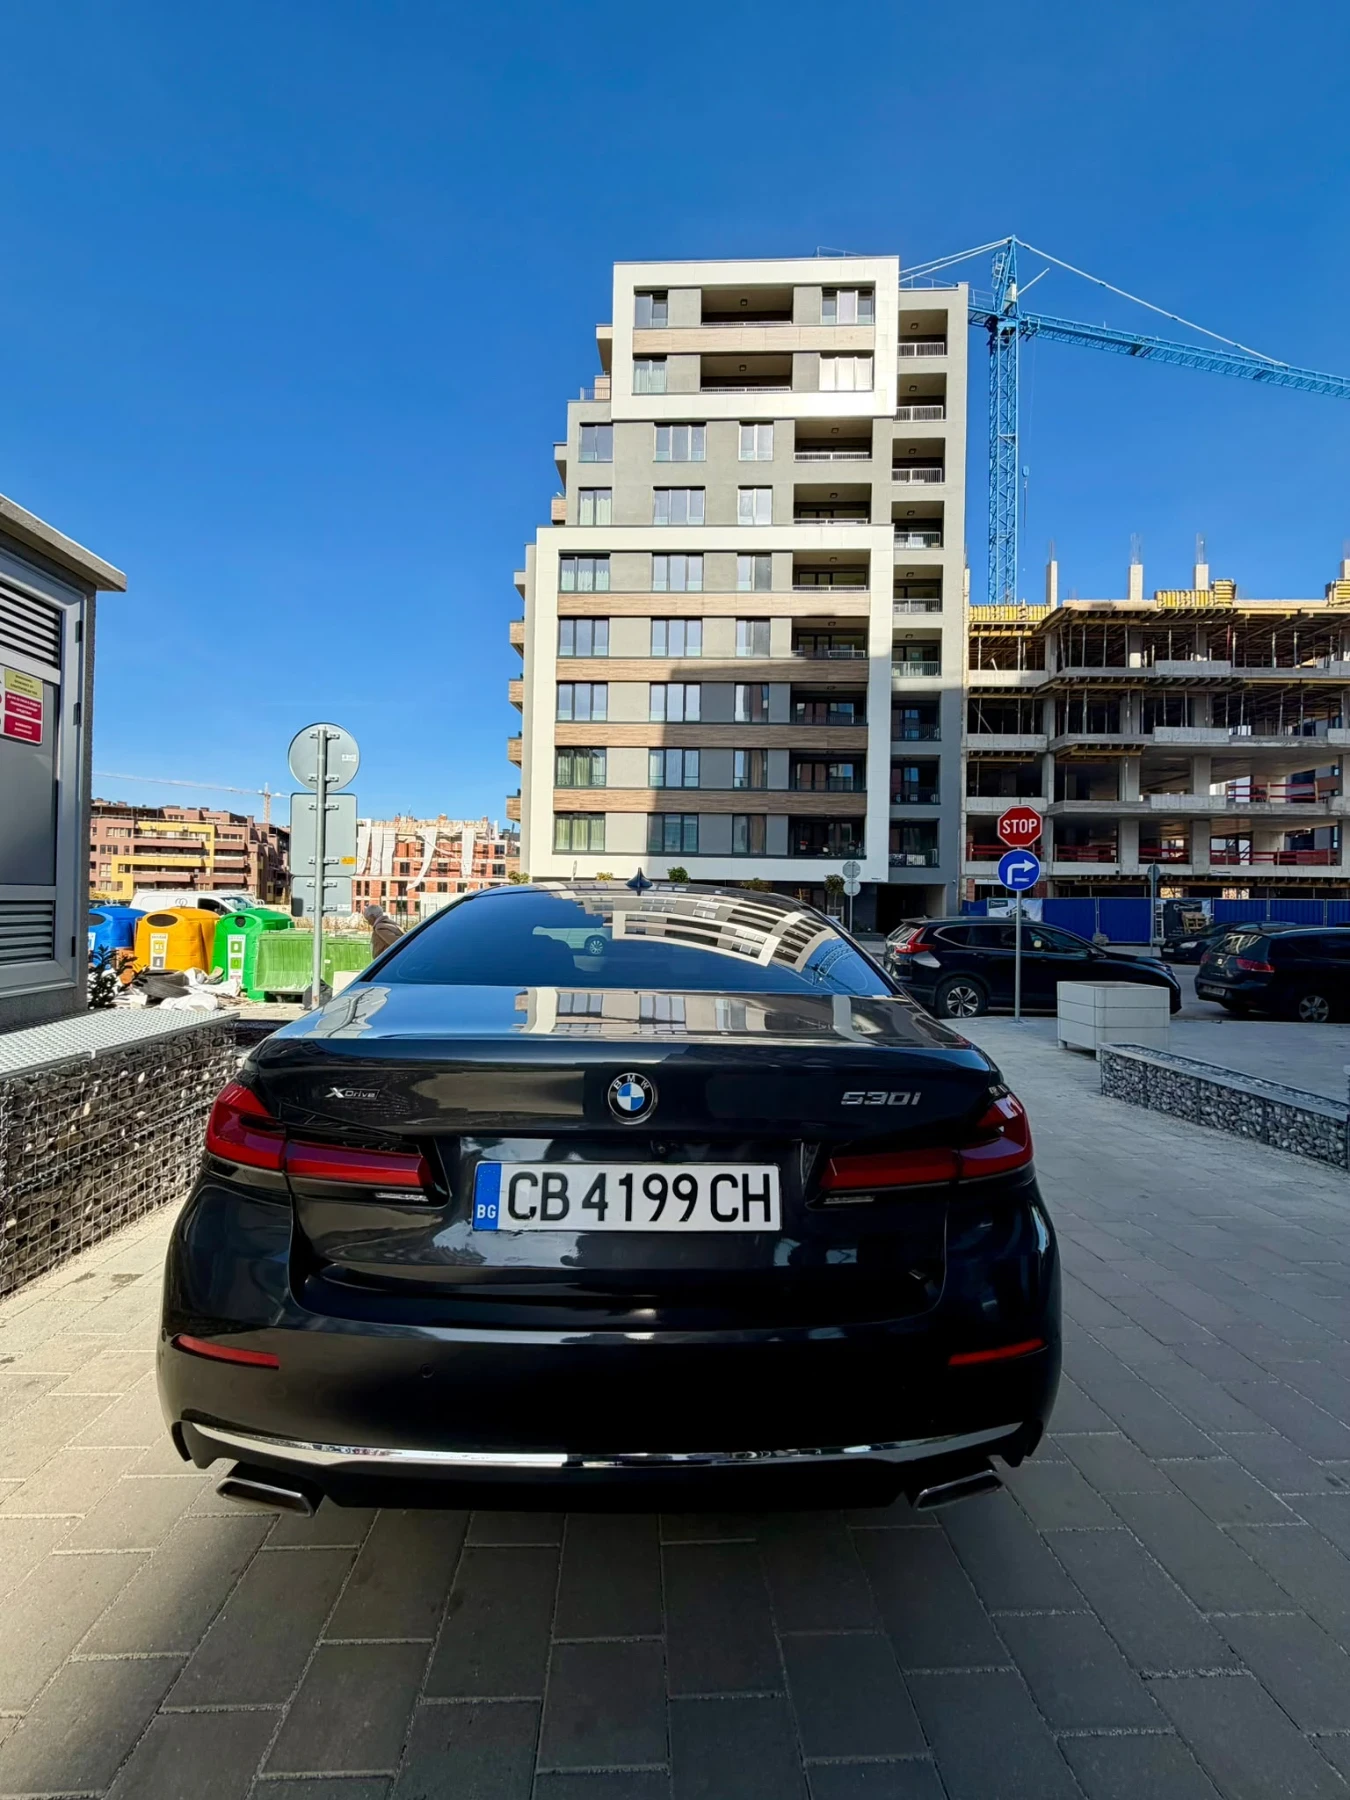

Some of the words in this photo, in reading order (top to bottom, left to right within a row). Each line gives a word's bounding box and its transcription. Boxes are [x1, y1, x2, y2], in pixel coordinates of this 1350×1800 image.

[1002, 818, 1038, 834] STOP
[613, 1074, 651, 1090] BMW
[508, 1171, 570, 1221] CB
[581, 1172, 698, 1222] 4199
[710, 1173, 771, 1223] CH
[476, 1203, 497, 1219] BG
